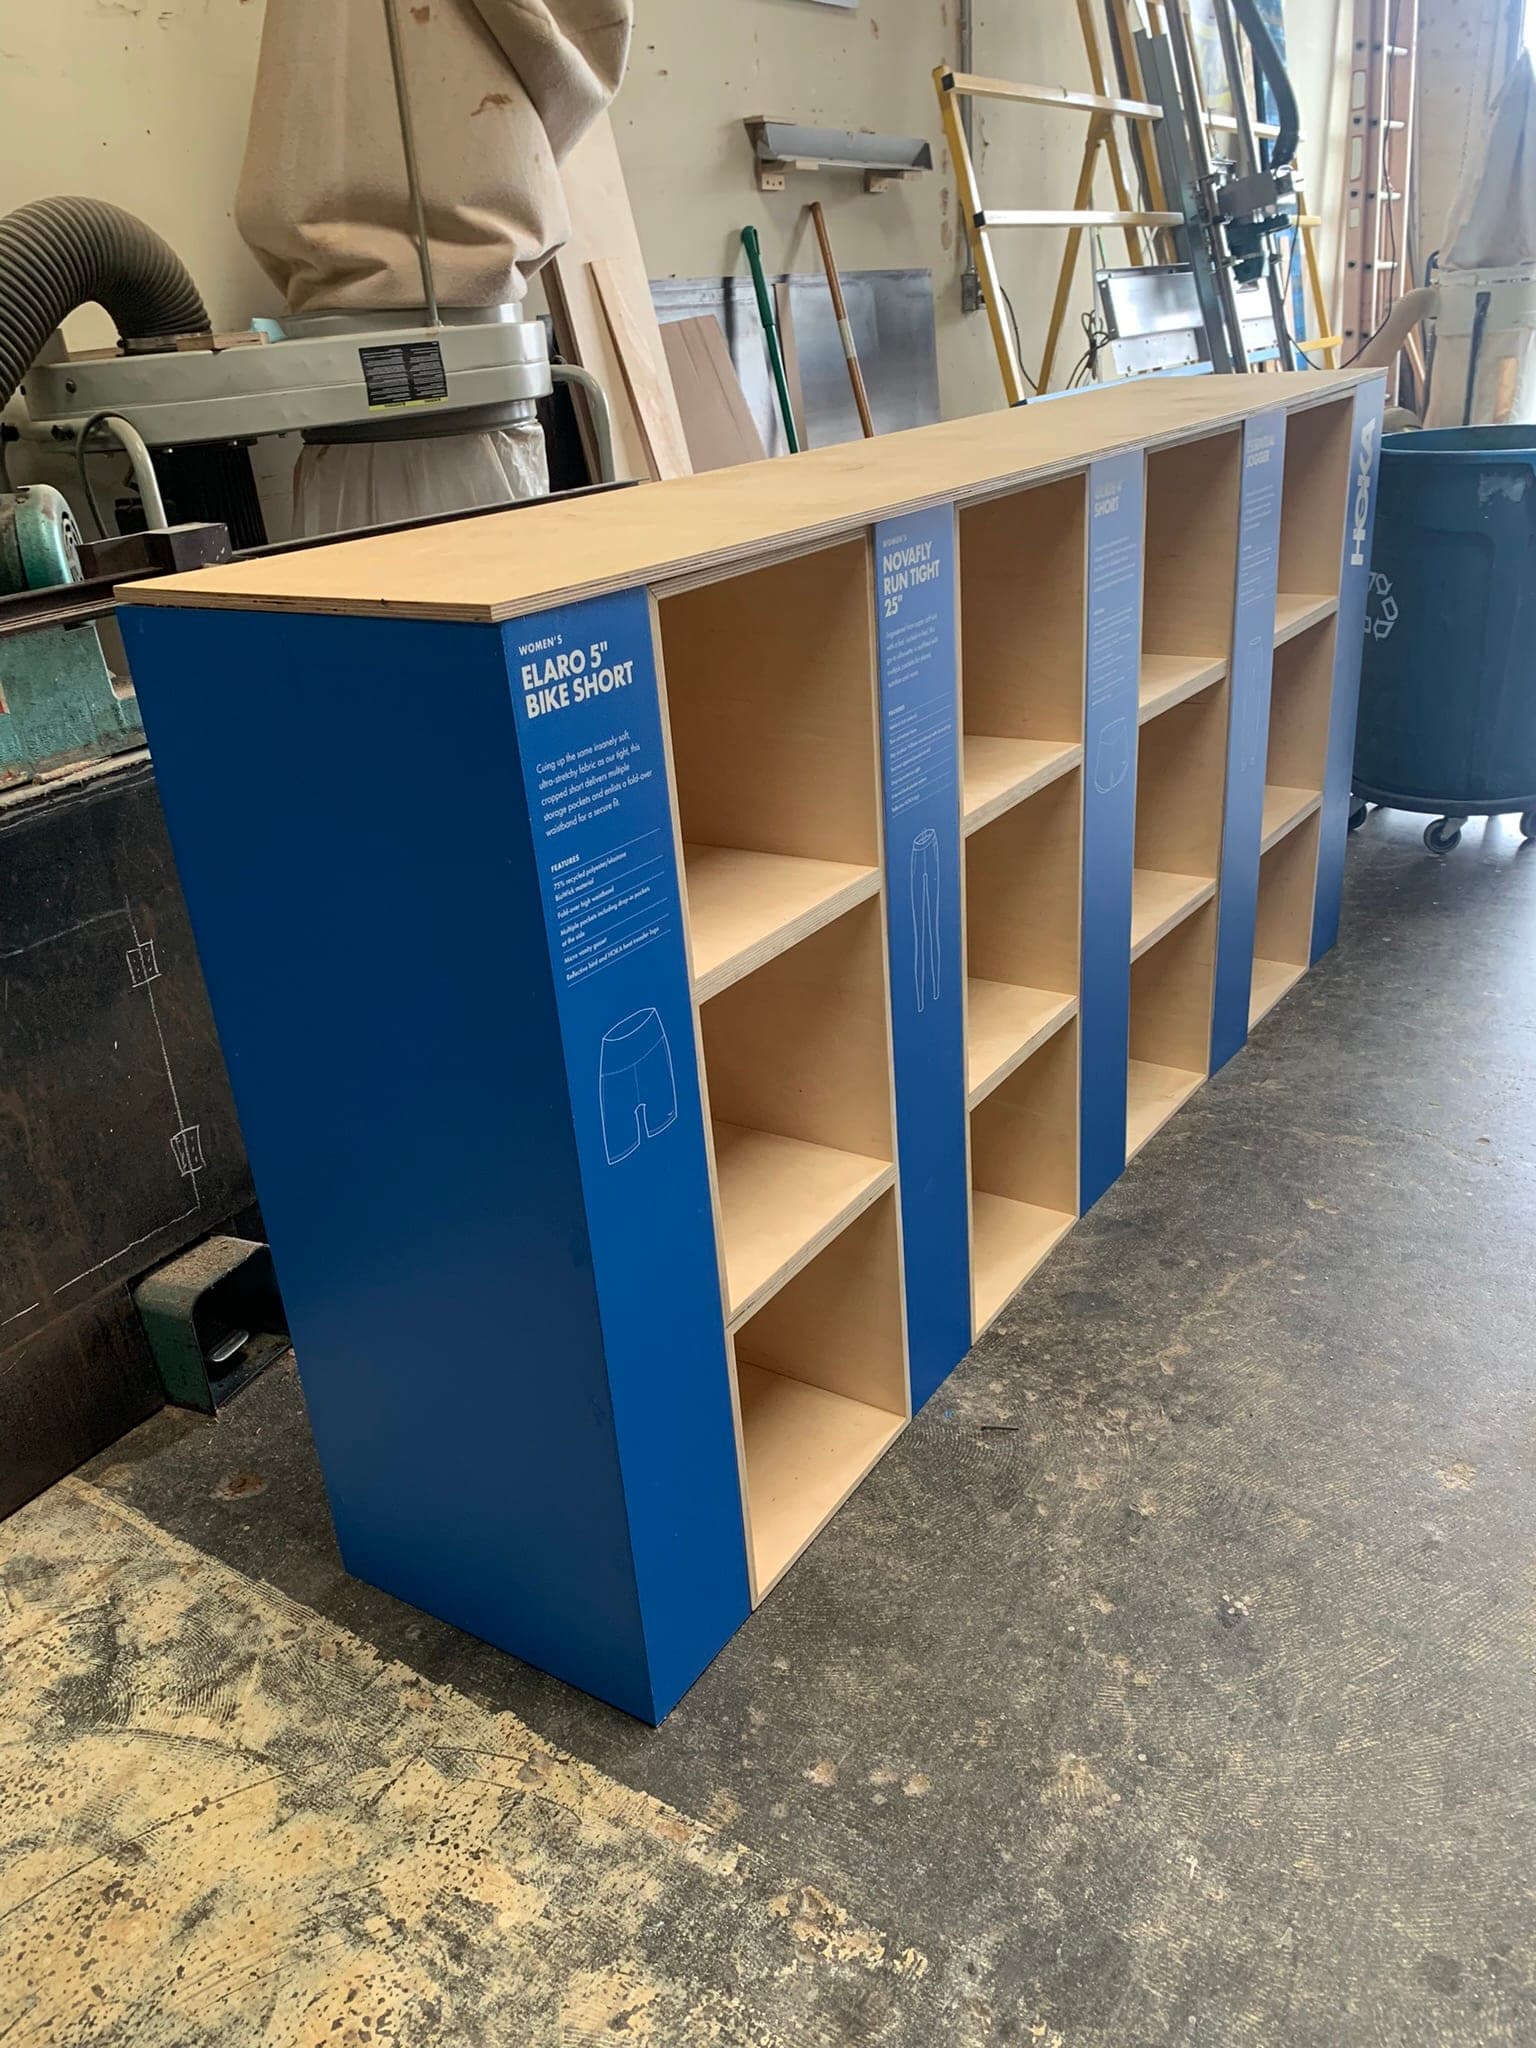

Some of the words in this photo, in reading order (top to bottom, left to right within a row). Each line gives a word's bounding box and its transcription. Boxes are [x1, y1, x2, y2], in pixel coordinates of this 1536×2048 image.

[1350, 417, 1376, 566] HOKA
[883, 541, 932, 574] NOVAFLY
[884, 572, 908, 596] RUN
[910, 560, 940, 586] TIGHT
[884, 594, 903, 618] 25"
[518, 634, 563, 656] WOMEN'S
[521, 649, 586, 691] ELARO
[590, 641, 608, 669] 5"
[525, 682, 570, 720] BIKE
[573, 661, 634, 702] SHORT
[539, 768, 578, 791] ultra-stretchy
[578, 762, 597, 774] fabric
[597, 758, 604, 767] as
[605, 754, 615, 764] our
[630, 742, 641, 753] this
[557, 758, 565, 768] up
[566, 752, 576, 762] the
[577, 747, 593, 759] same
[594, 736, 617, 752] insanely
[541, 787, 568, 806] cropped
[569, 781, 584, 795] short
[585, 774, 607, 788] delivers
[608, 763, 630, 778] multiple
[543, 806, 567, 821] storage
[568, 797, 591, 813] pockets
[591, 789, 604, 801] and
[627, 770, 653, 785] fold-over
[545, 816, 578, 837] waistband
[578, 812, 587, 823] for
[588, 811, 593, 819] a
[594, 803, 613, 816] secure
[550, 854, 580, 873] FEATURES
